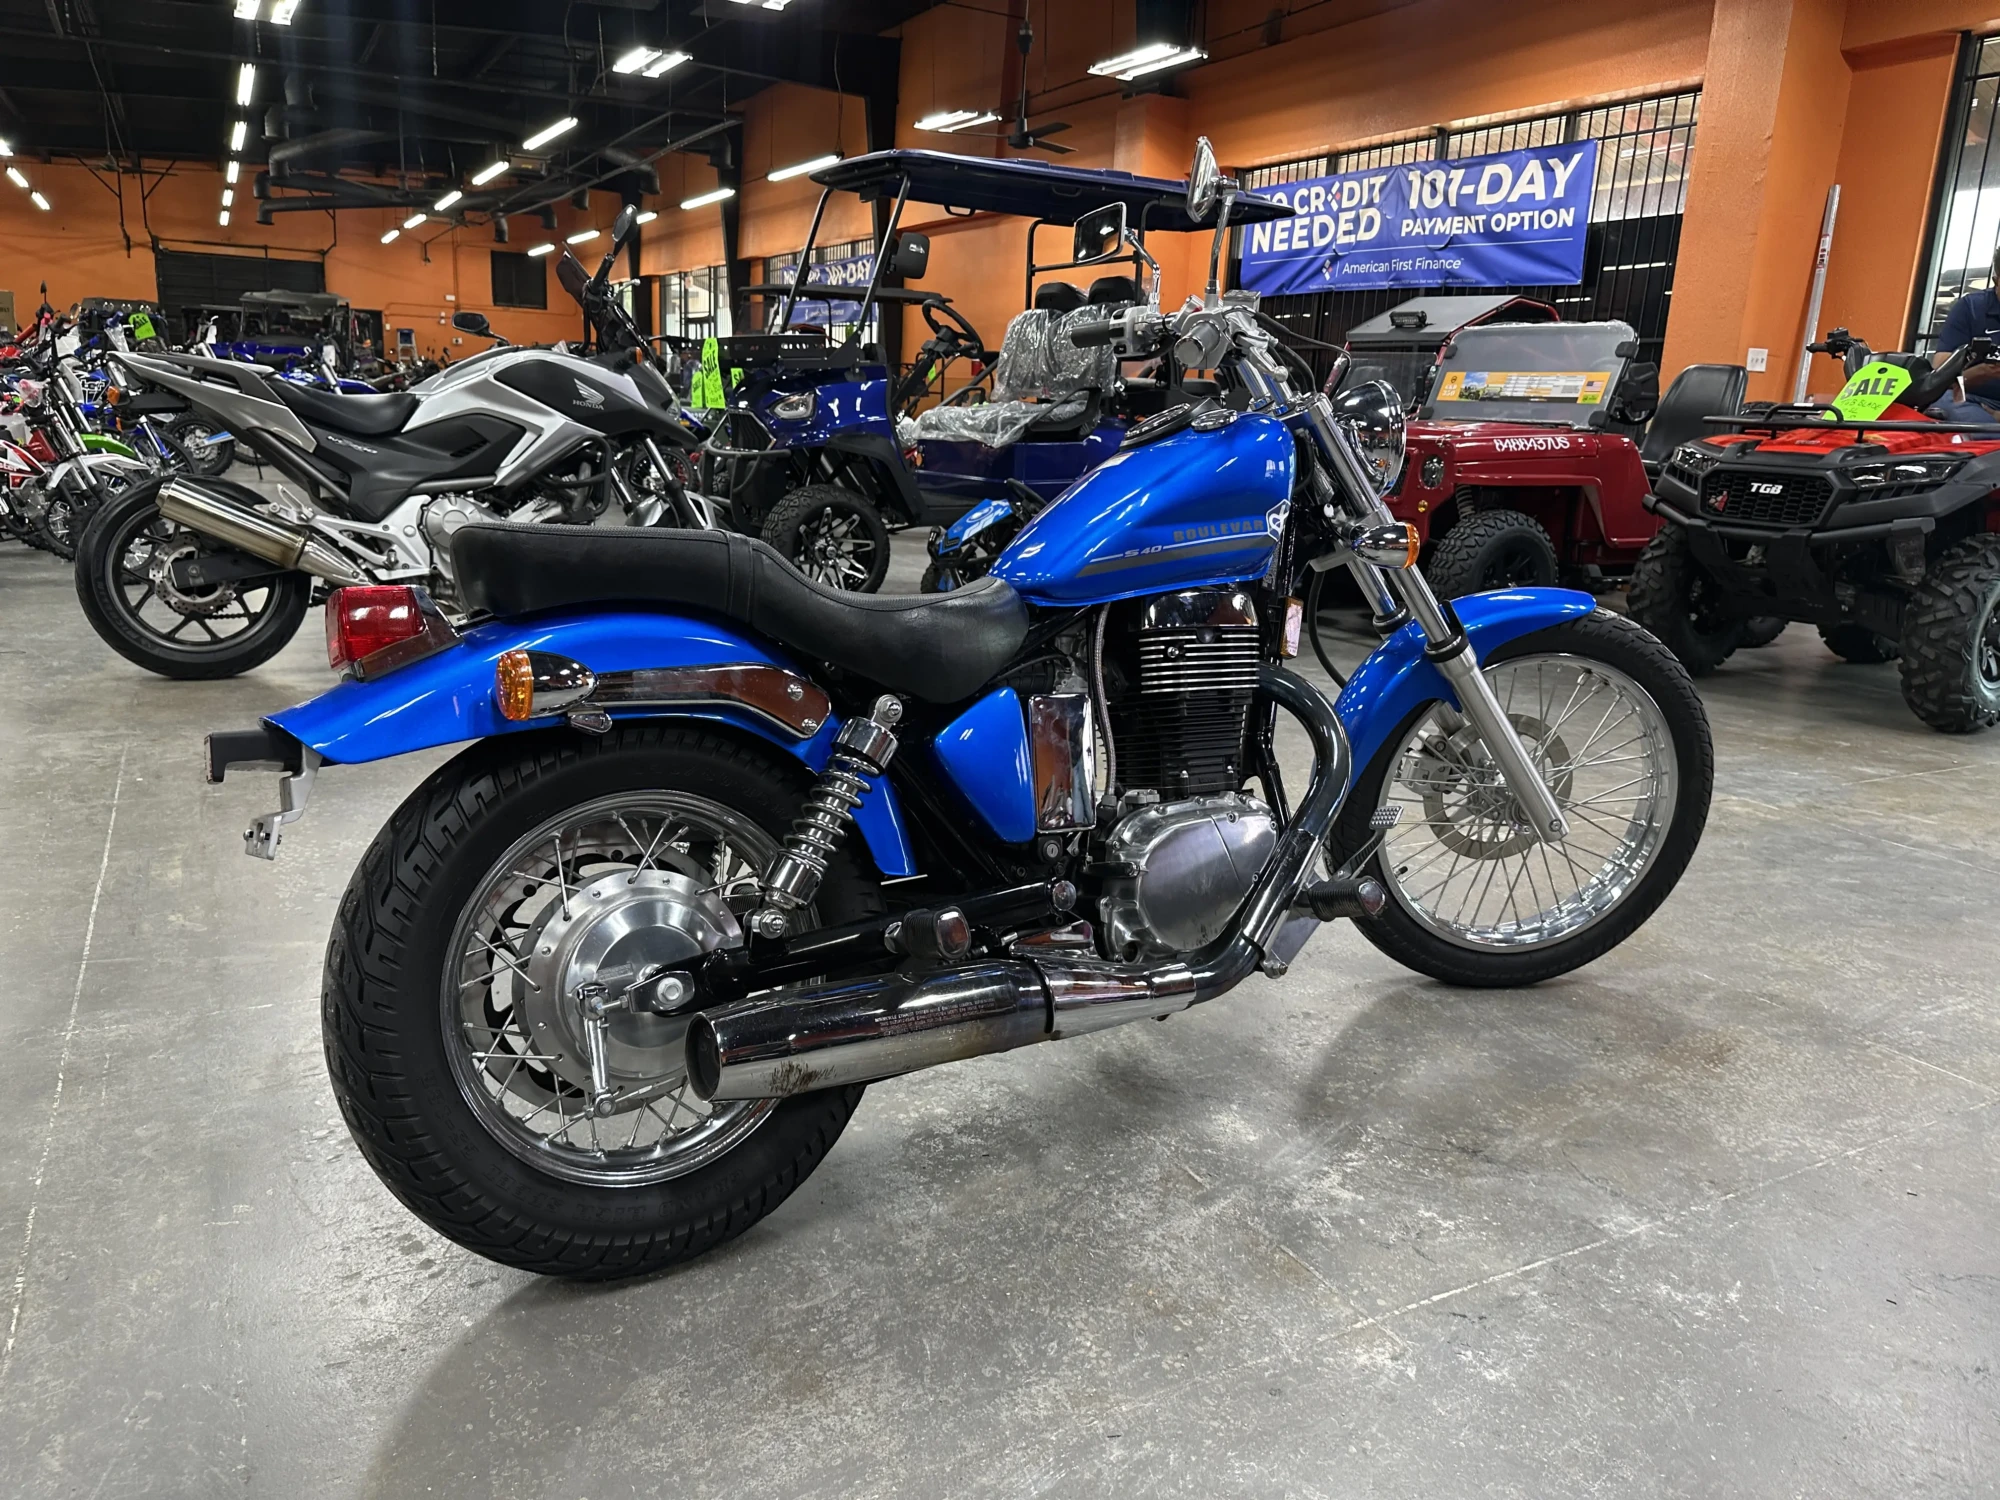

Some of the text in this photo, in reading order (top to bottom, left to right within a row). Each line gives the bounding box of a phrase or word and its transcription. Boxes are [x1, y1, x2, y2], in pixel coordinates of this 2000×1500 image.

[1408, 152, 1584, 210] 101-DAY
[1251, 207, 1381, 254] NEEDED
[1401, 207, 1575, 237] PAYMENT OPTION
[1342, 260, 1390, 275] American
[1391, 258, 1413, 272] First
[1840, 377, 1899, 400] SALE
[572, 399, 605, 410] HONDA
[1750, 482, 1783, 495] TGB
[1124, 545, 1162, 558] S40
